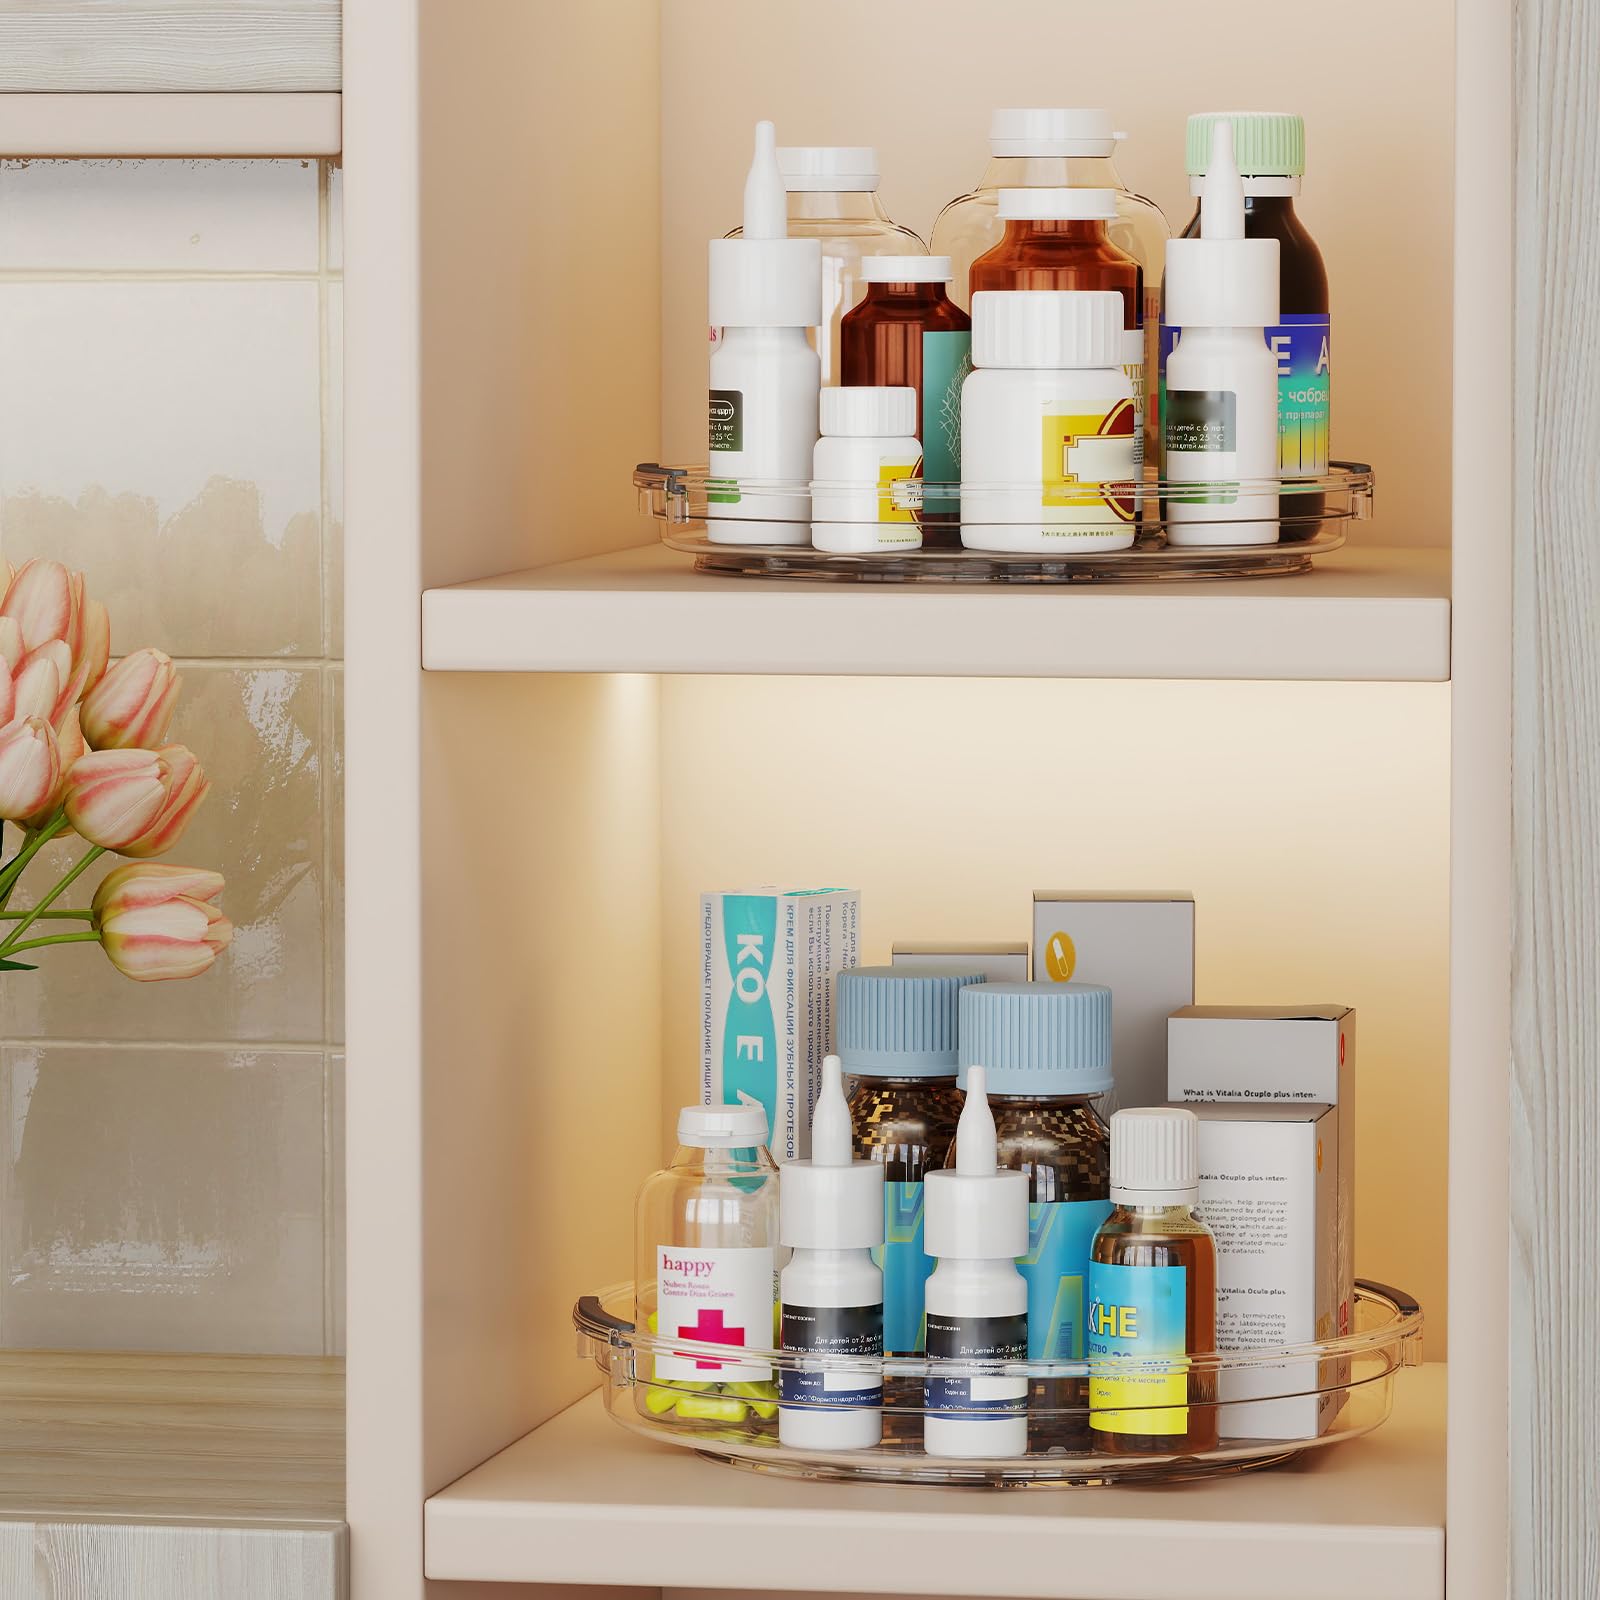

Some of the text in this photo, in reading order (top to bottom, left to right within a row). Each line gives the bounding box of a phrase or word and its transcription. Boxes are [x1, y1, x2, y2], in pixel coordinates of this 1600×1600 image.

[704, 902, 712, 990] ПРЕДОТВРАЩАЕТ
[704, 992, 712, 1055] ПОПАДАНИЕ
[786, 904, 794, 1159] КРЕМ ДЛЯ ФИКСАЦИИ ЗУБНЫХ ПРОТЕЗОВ
[1183, 1089, 1205, 1097] What
[1206, 1089, 1214, 1097] is
[1215, 1089, 1242, 1097] Vitalia
[1273, 1091, 1291, 1099] plus
[1247, 1174, 1264, 1182] plus
[1245, 1207, 1254, 1215] by
[663, 1254, 716, 1278] happy
